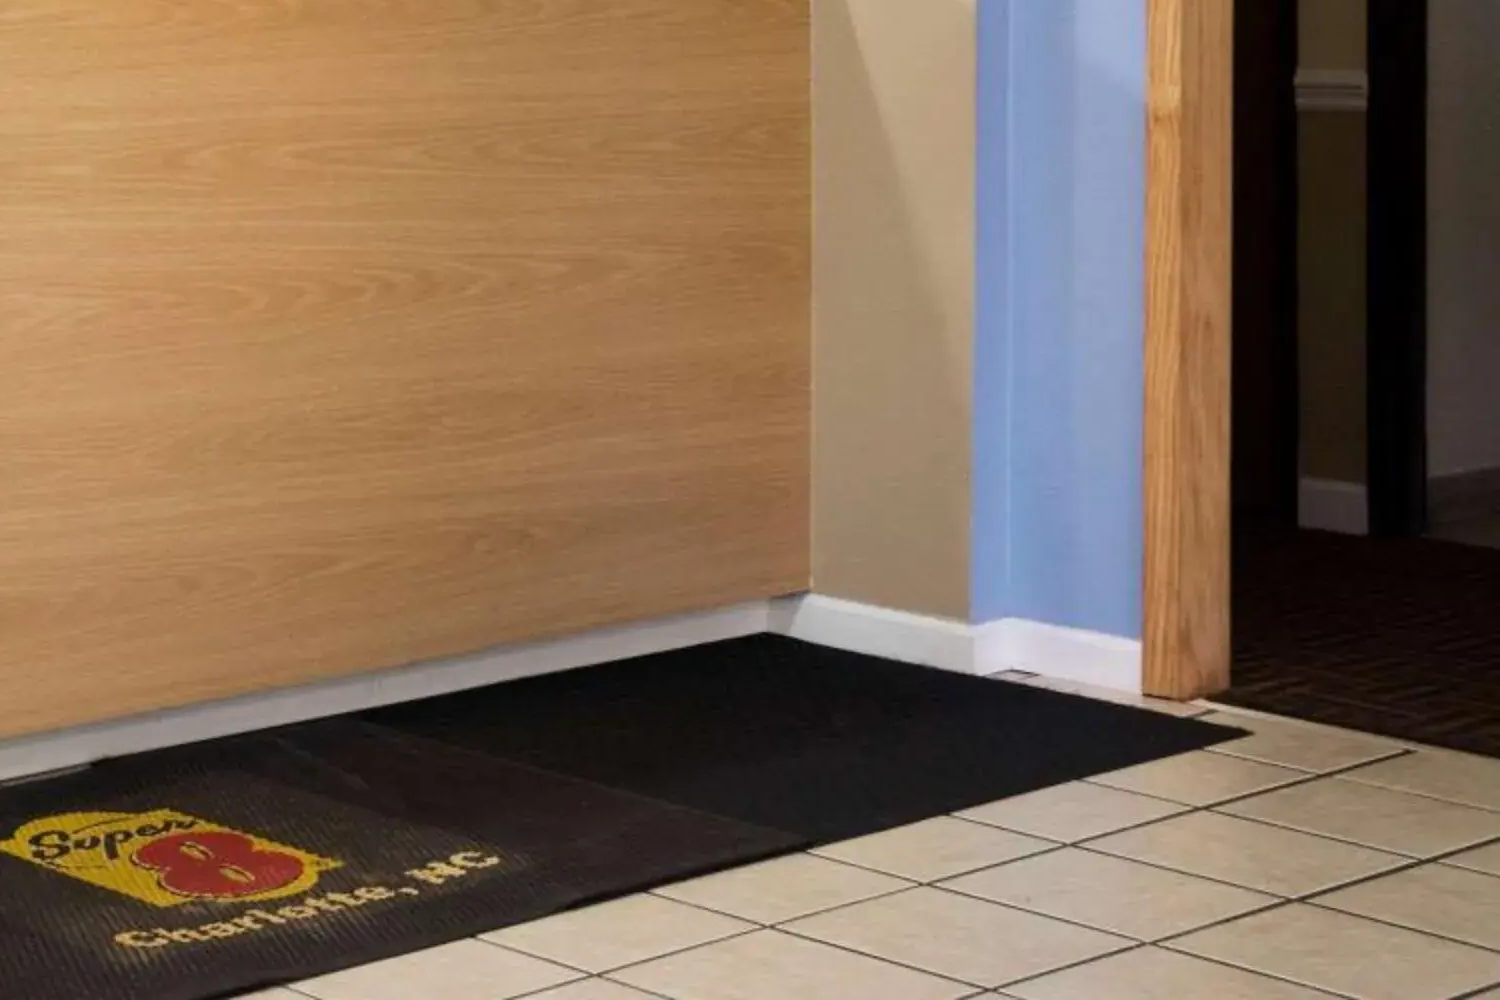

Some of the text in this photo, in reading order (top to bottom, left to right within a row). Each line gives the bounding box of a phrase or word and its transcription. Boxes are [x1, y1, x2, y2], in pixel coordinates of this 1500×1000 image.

[28, 818, 200, 861] Super
[132, 831, 306, 897] 8
[404, 850, 500, 885] NC
